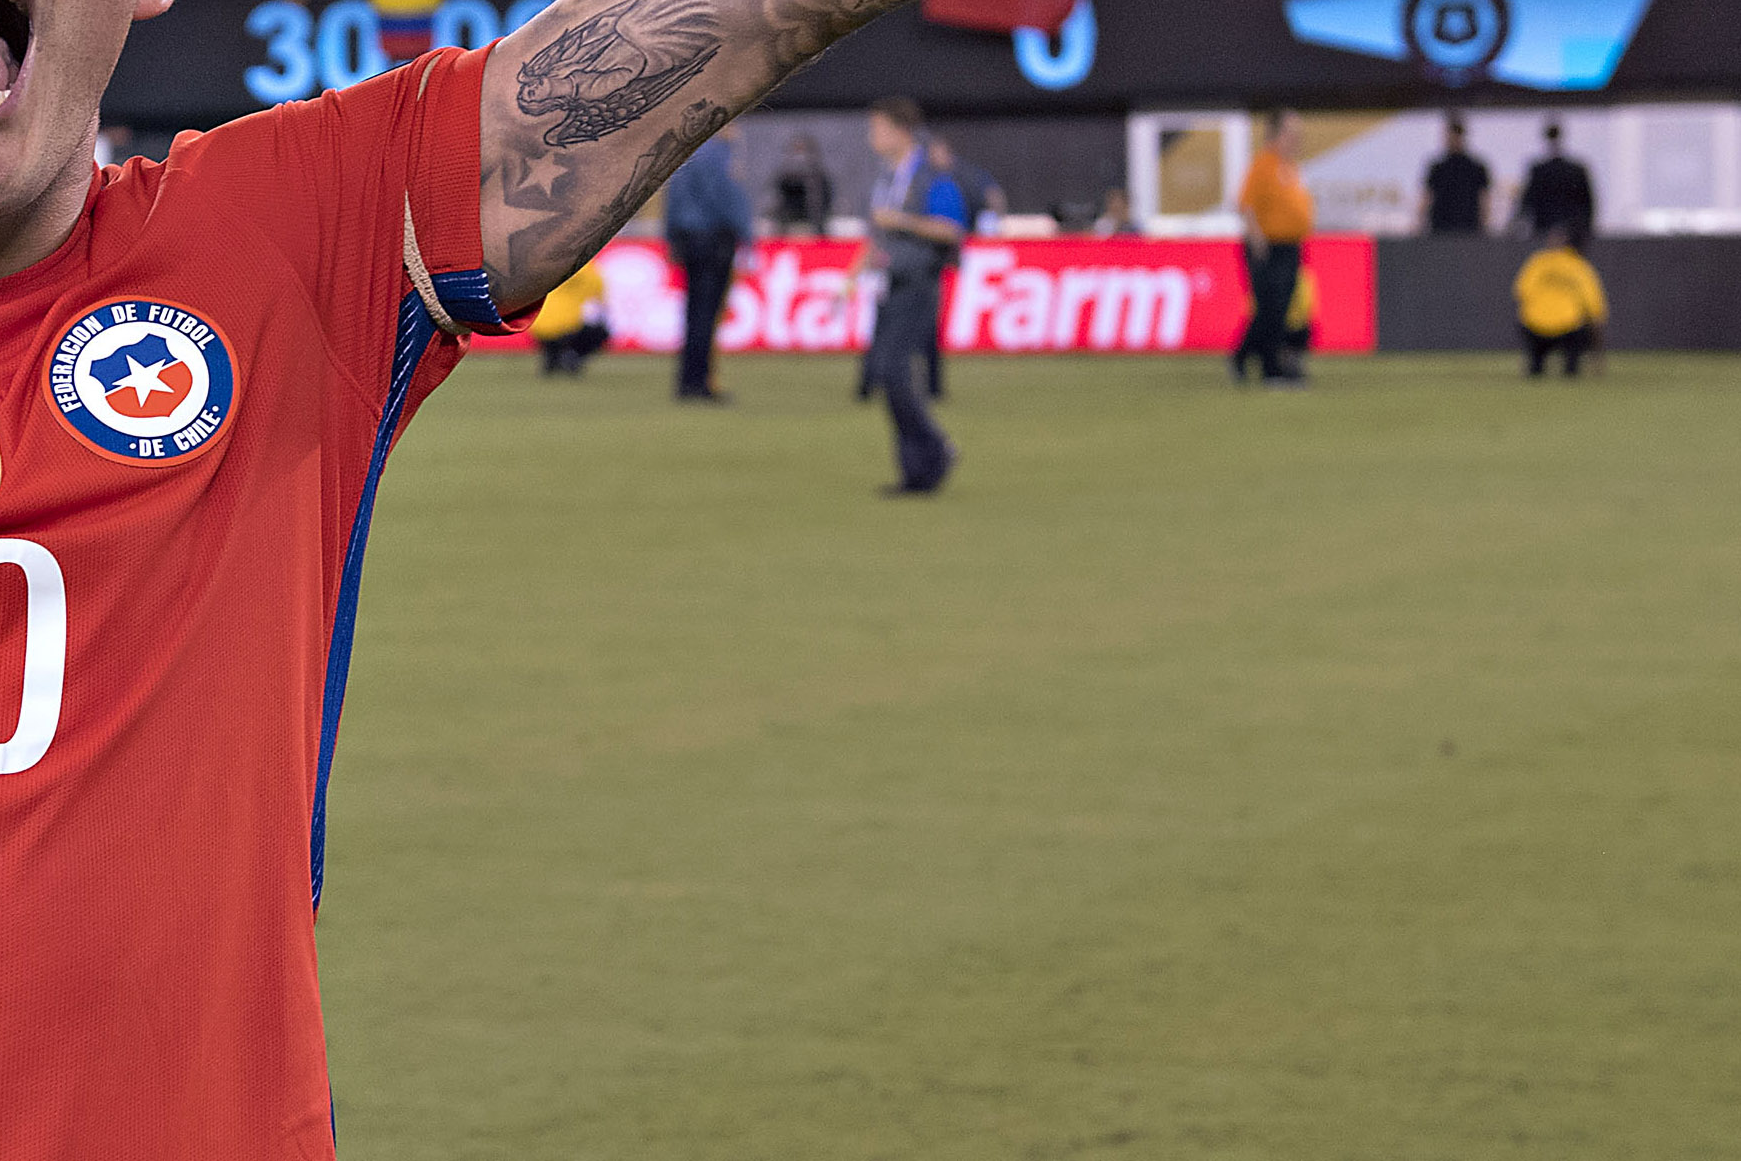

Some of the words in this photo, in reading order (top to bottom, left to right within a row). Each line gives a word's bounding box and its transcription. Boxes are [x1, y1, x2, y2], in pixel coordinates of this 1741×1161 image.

[945, 246, 1192, 352] Farm
[52, 315, 104, 413] FEDERACION
[111, 304, 138, 324] DE
[148, 305, 215, 351] FUTBOL
[139, 439, 165, 457] DE
[173, 409, 221, 451] CHILE
